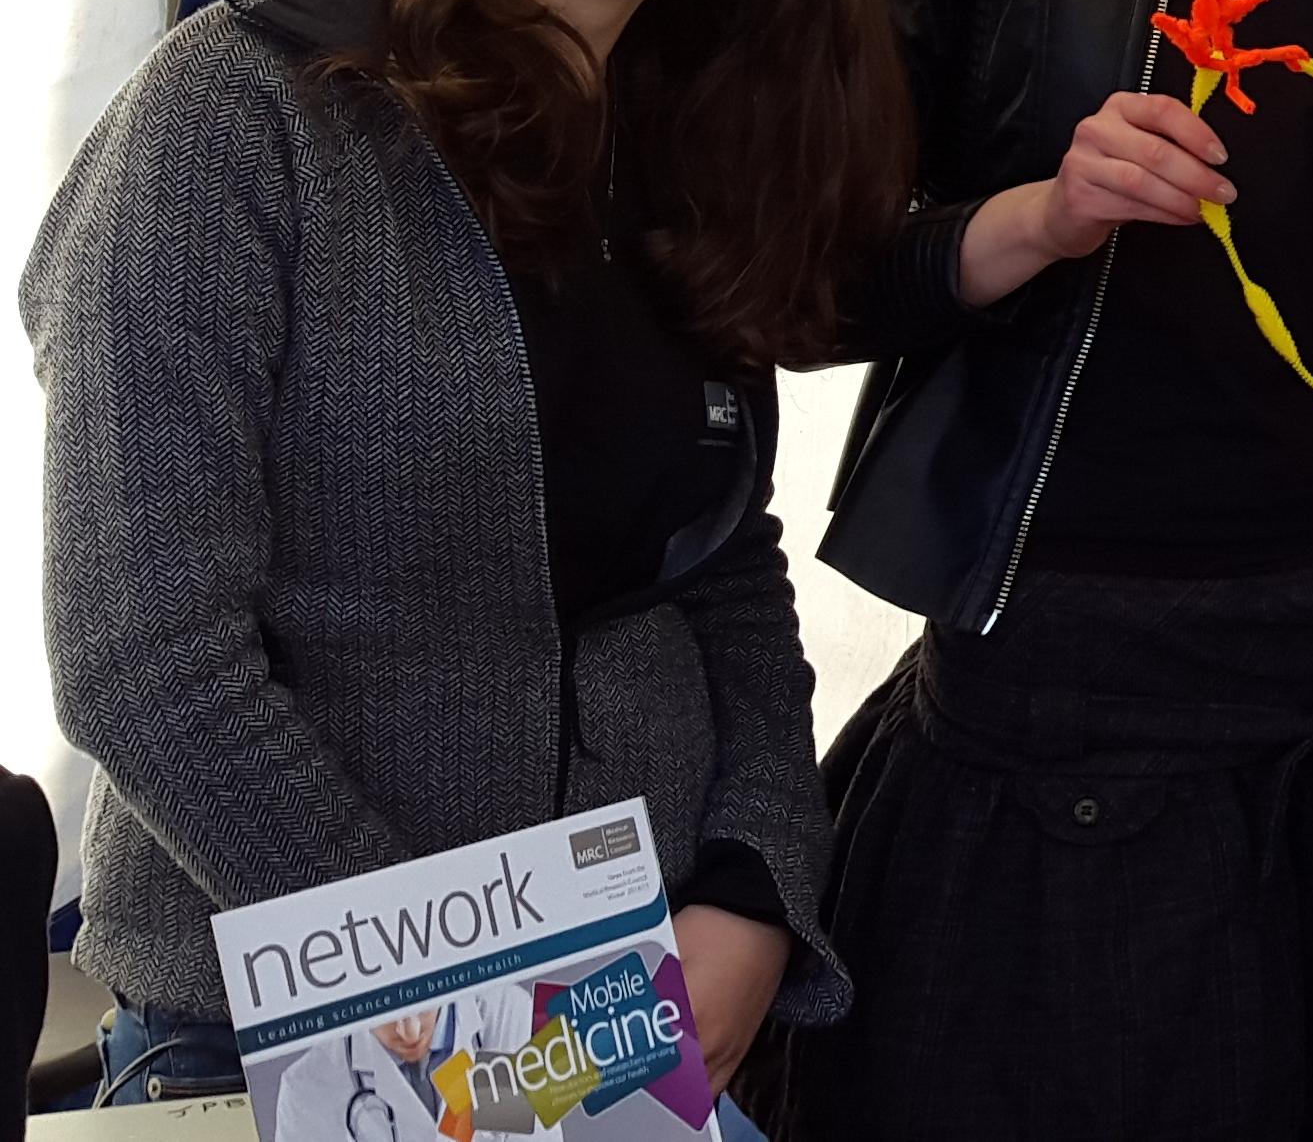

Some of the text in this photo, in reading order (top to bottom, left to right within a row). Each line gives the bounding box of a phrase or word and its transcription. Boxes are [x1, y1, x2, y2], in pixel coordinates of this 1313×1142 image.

[576, 845, 605, 865] MRC
[242, 852, 545, 1008] network
[257, 954, 523, 1044] Leading science for better health
[569, 969, 646, 1016] Mobile
[465, 999, 684, 1111] medicine
